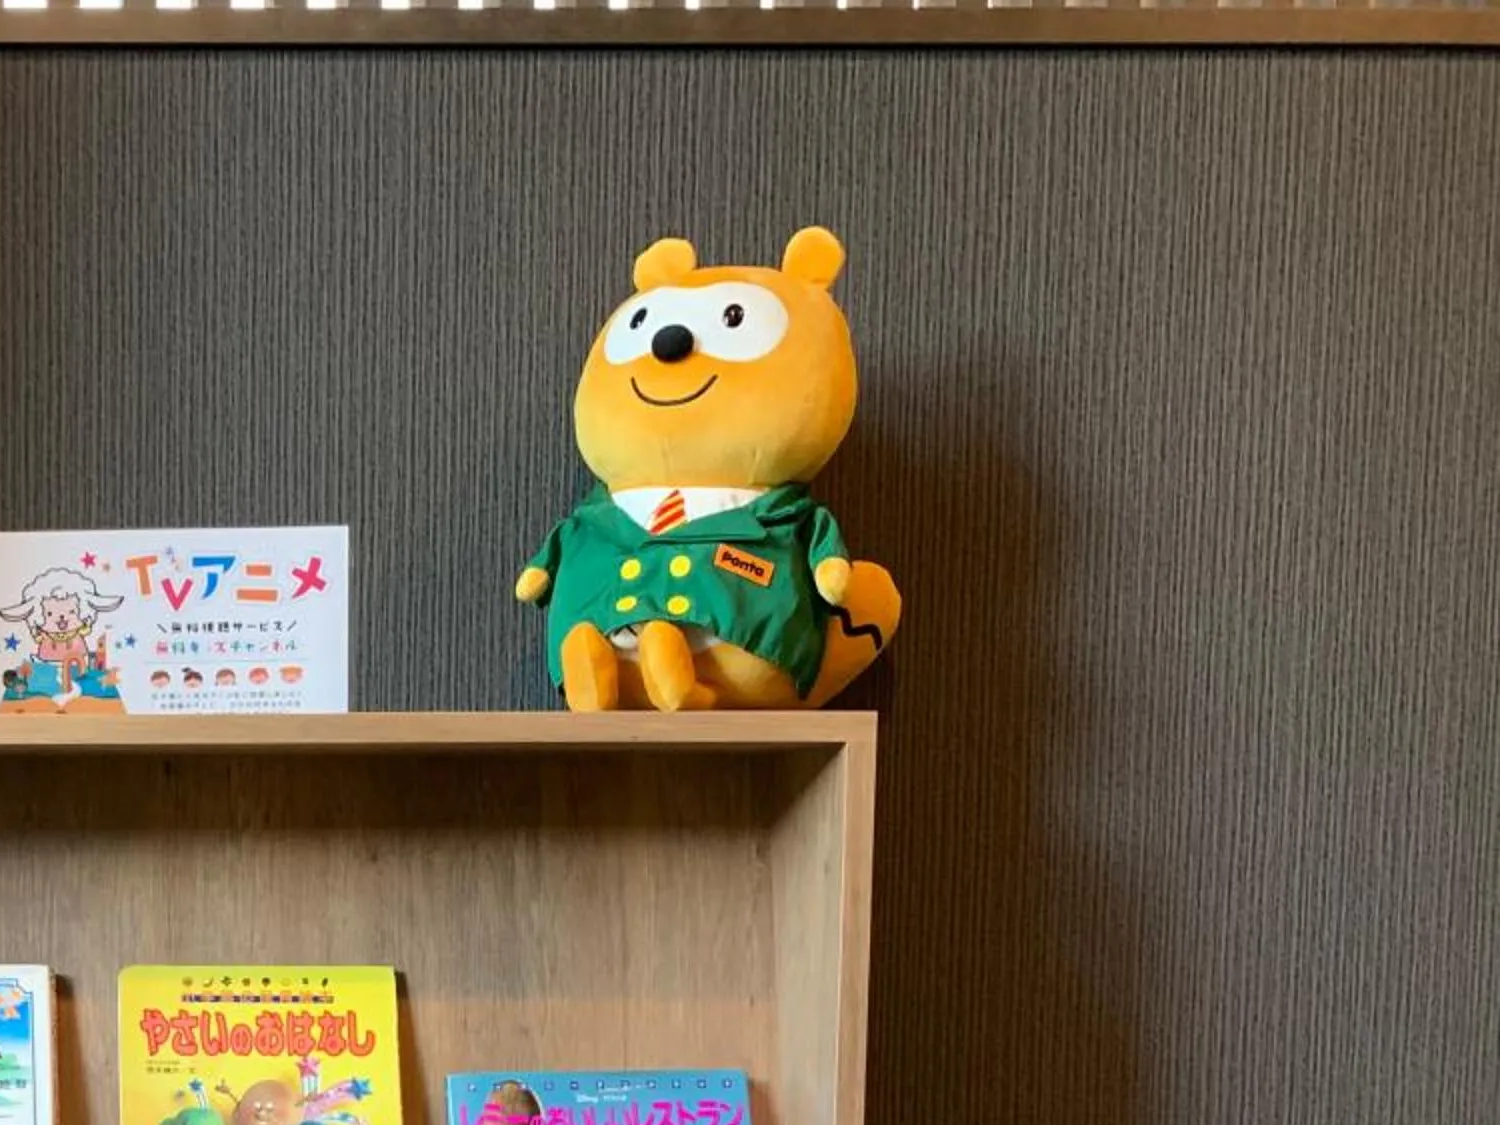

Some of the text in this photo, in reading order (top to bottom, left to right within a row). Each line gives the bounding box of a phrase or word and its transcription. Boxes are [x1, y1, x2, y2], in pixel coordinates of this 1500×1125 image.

[125, 554, 328, 612] TVアニメ
[140, 1008, 376, 1057] やさいのおはなし
